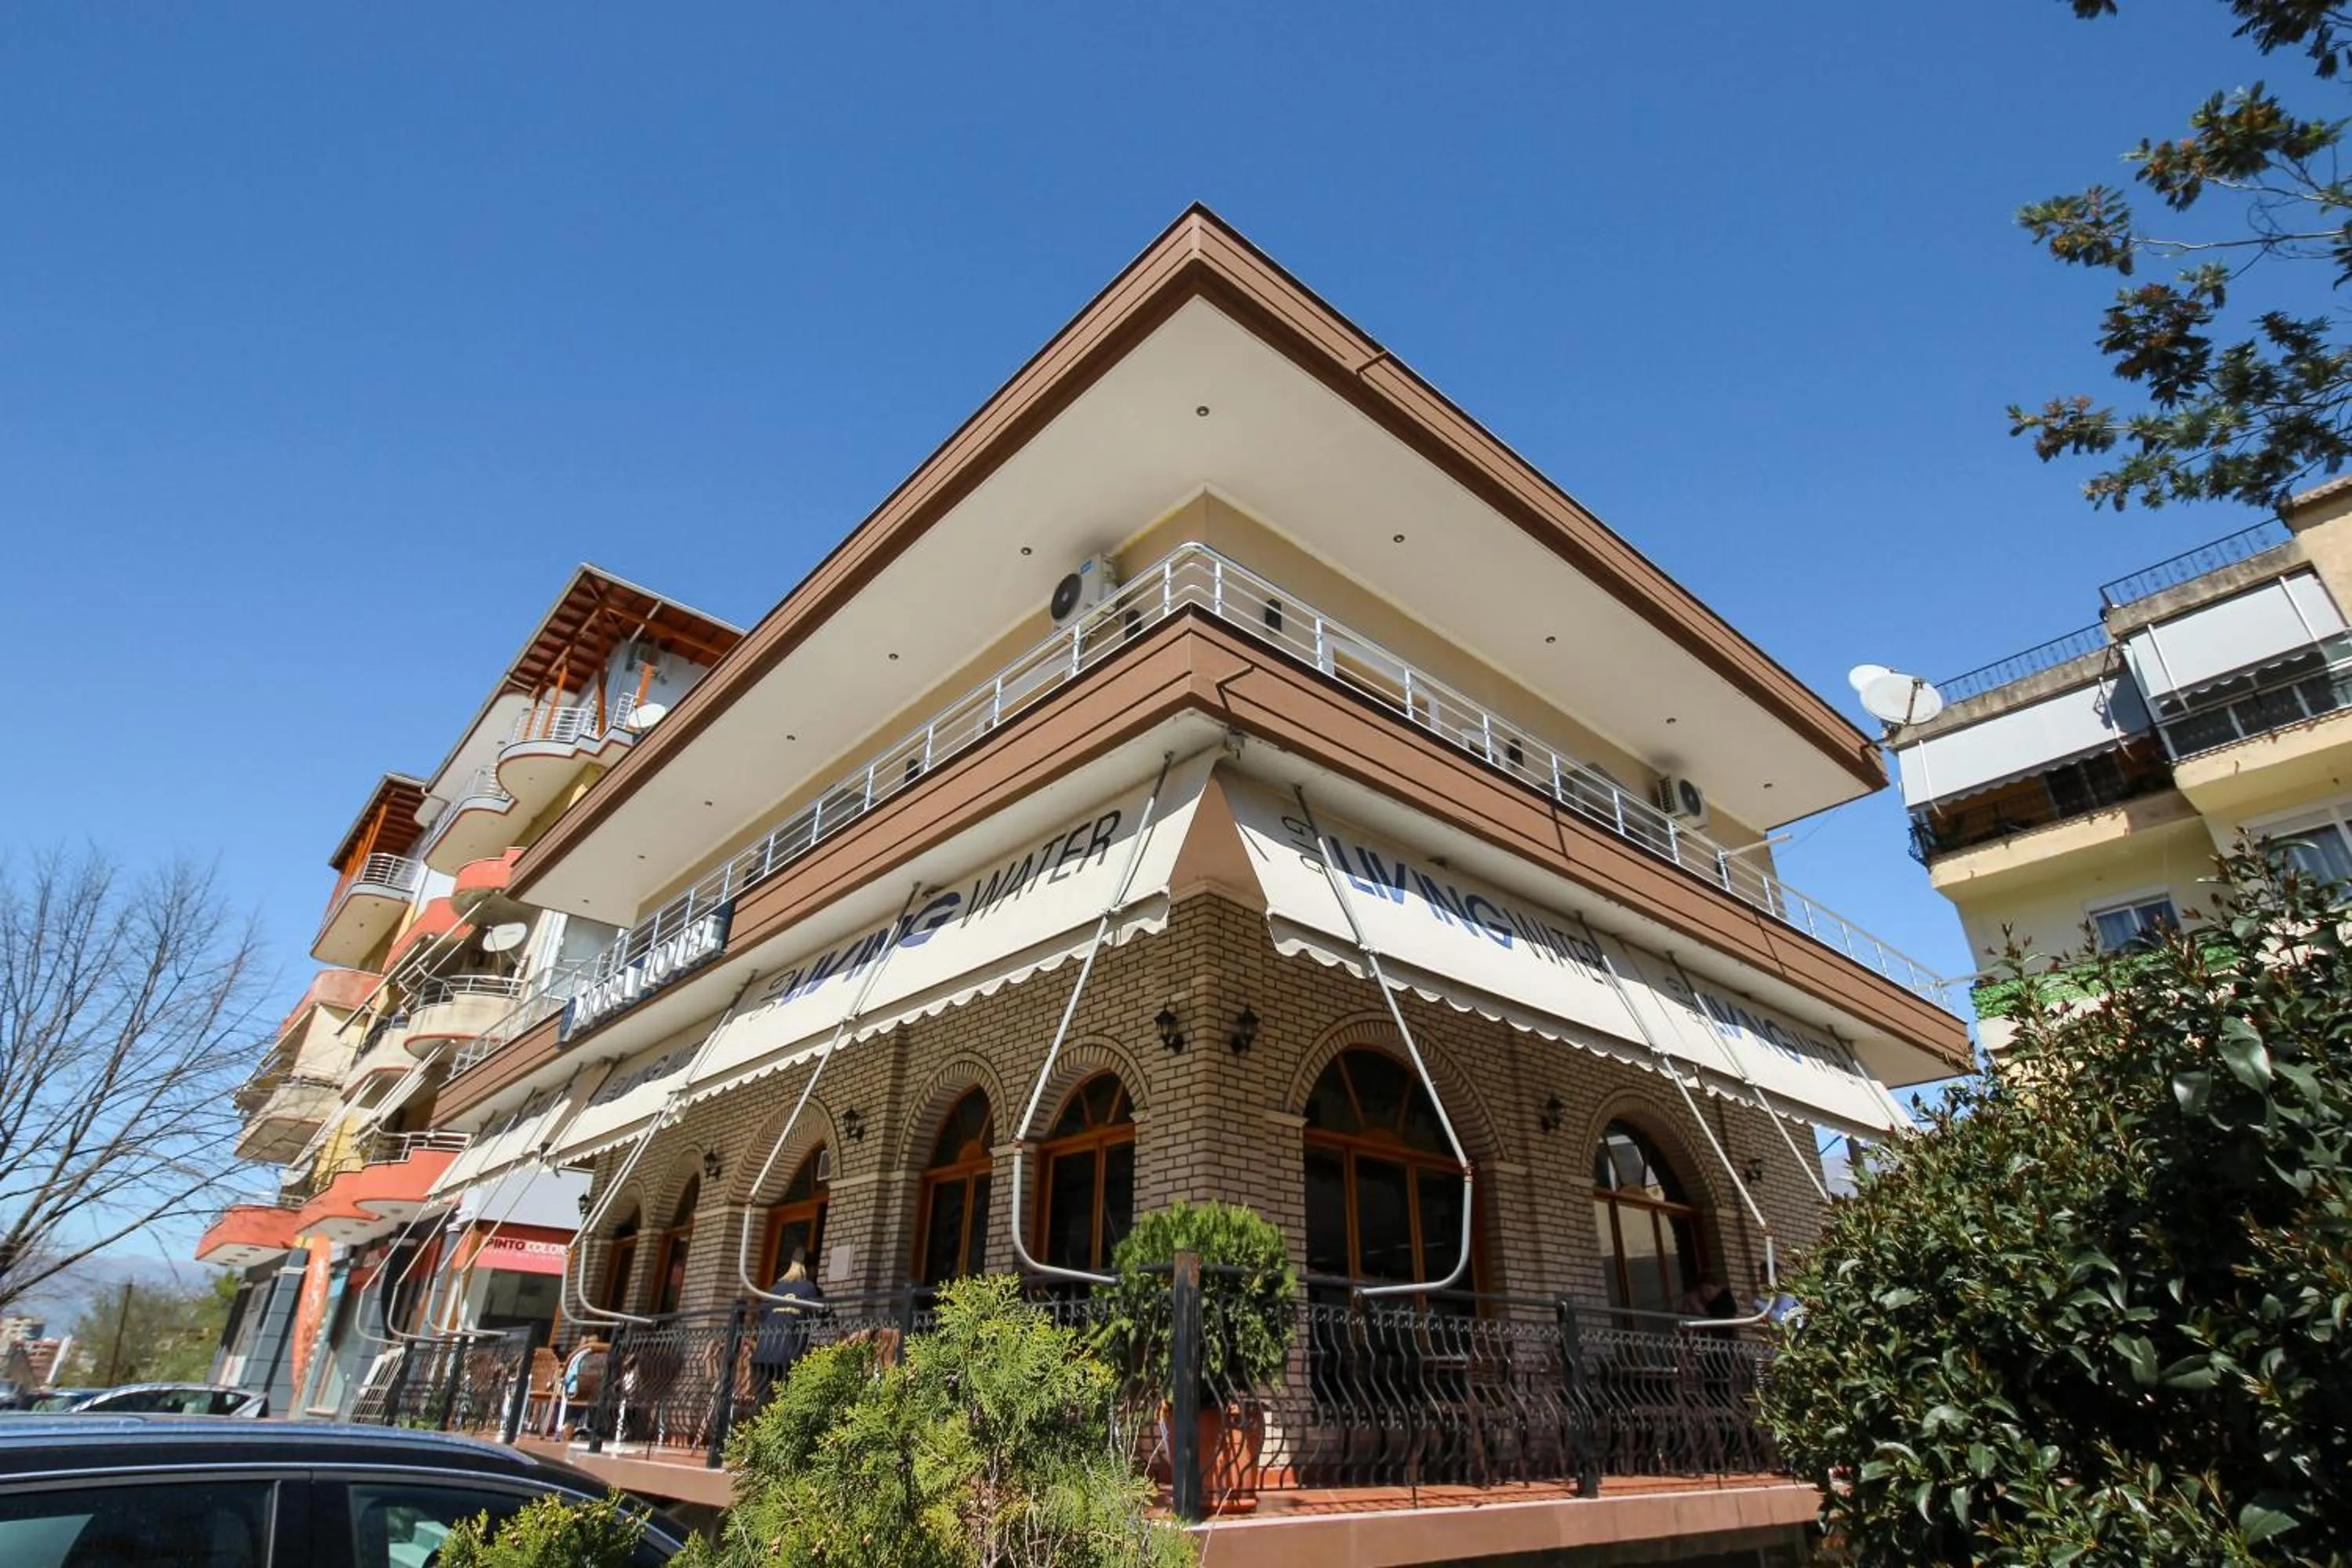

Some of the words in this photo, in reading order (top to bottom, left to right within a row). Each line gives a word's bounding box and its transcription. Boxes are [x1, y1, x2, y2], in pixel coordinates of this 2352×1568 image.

[779, 891, 961, 1006] LIVING
[960, 809, 1122, 928] WATER
[1328, 835, 1513, 950] LIVING
[1502, 907, 1621, 991] WATER
[486, 1238, 525, 1251] PINTO
